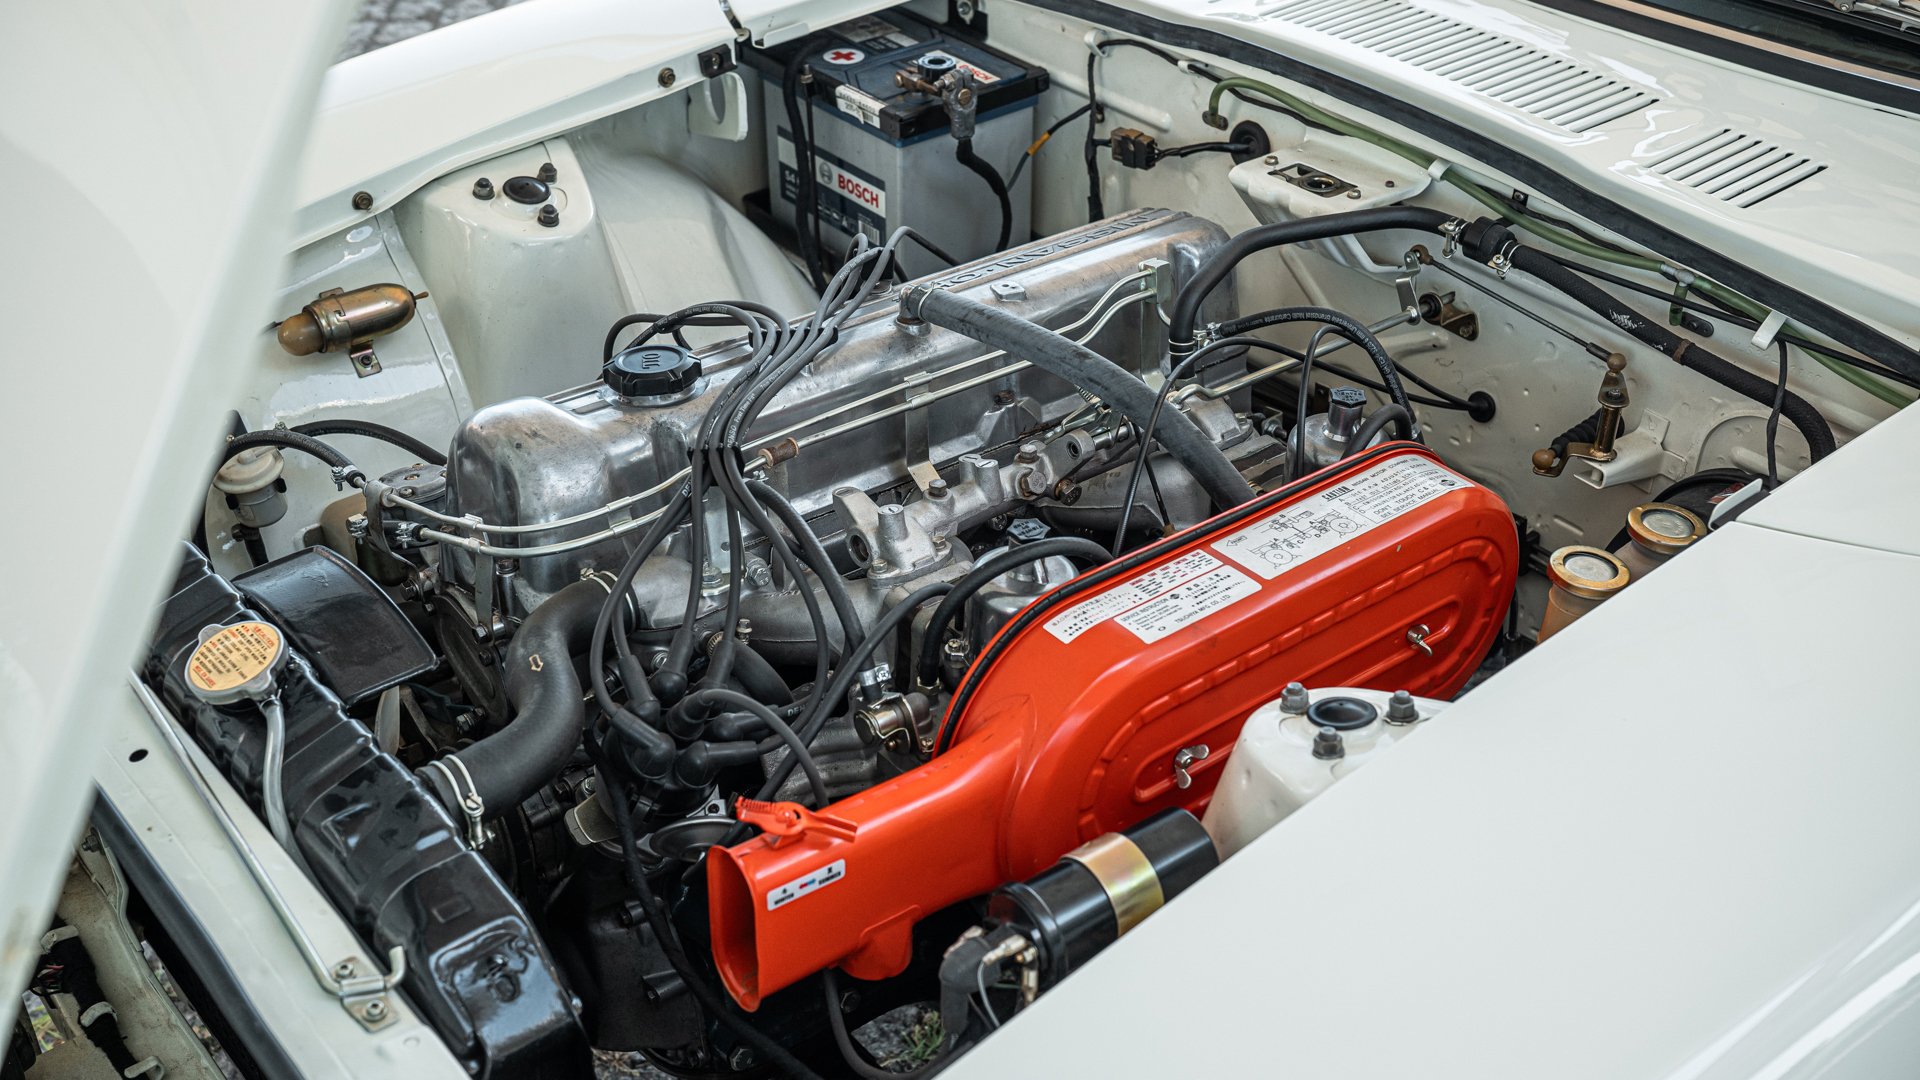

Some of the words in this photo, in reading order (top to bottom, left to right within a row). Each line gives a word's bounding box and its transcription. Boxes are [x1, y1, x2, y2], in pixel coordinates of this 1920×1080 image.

[837, 173, 879, 209] BOSCH
[996, 214, 1149, 269] NISSAN
[642, 353, 661, 369] OIL
[727, 425, 737, 448] DENSO
[1351, 477, 1369, 486] NISSAN
[1369, 468, 1388, 477] MOTOR
[1379, 467, 1411, 482] ADJUSTING
[1320, 484, 1350, 500] CAUTION
[1392, 499, 1417, 511] SERVICE
[1416, 488, 1440, 499] MANUAL
[1395, 493, 1416, 503] TOUCH
[1120, 611, 1140, 621] SERVICE
[1138, 597, 1169, 613] INSTRUCTION
[1173, 610, 1199, 623] TSUCHIYA
